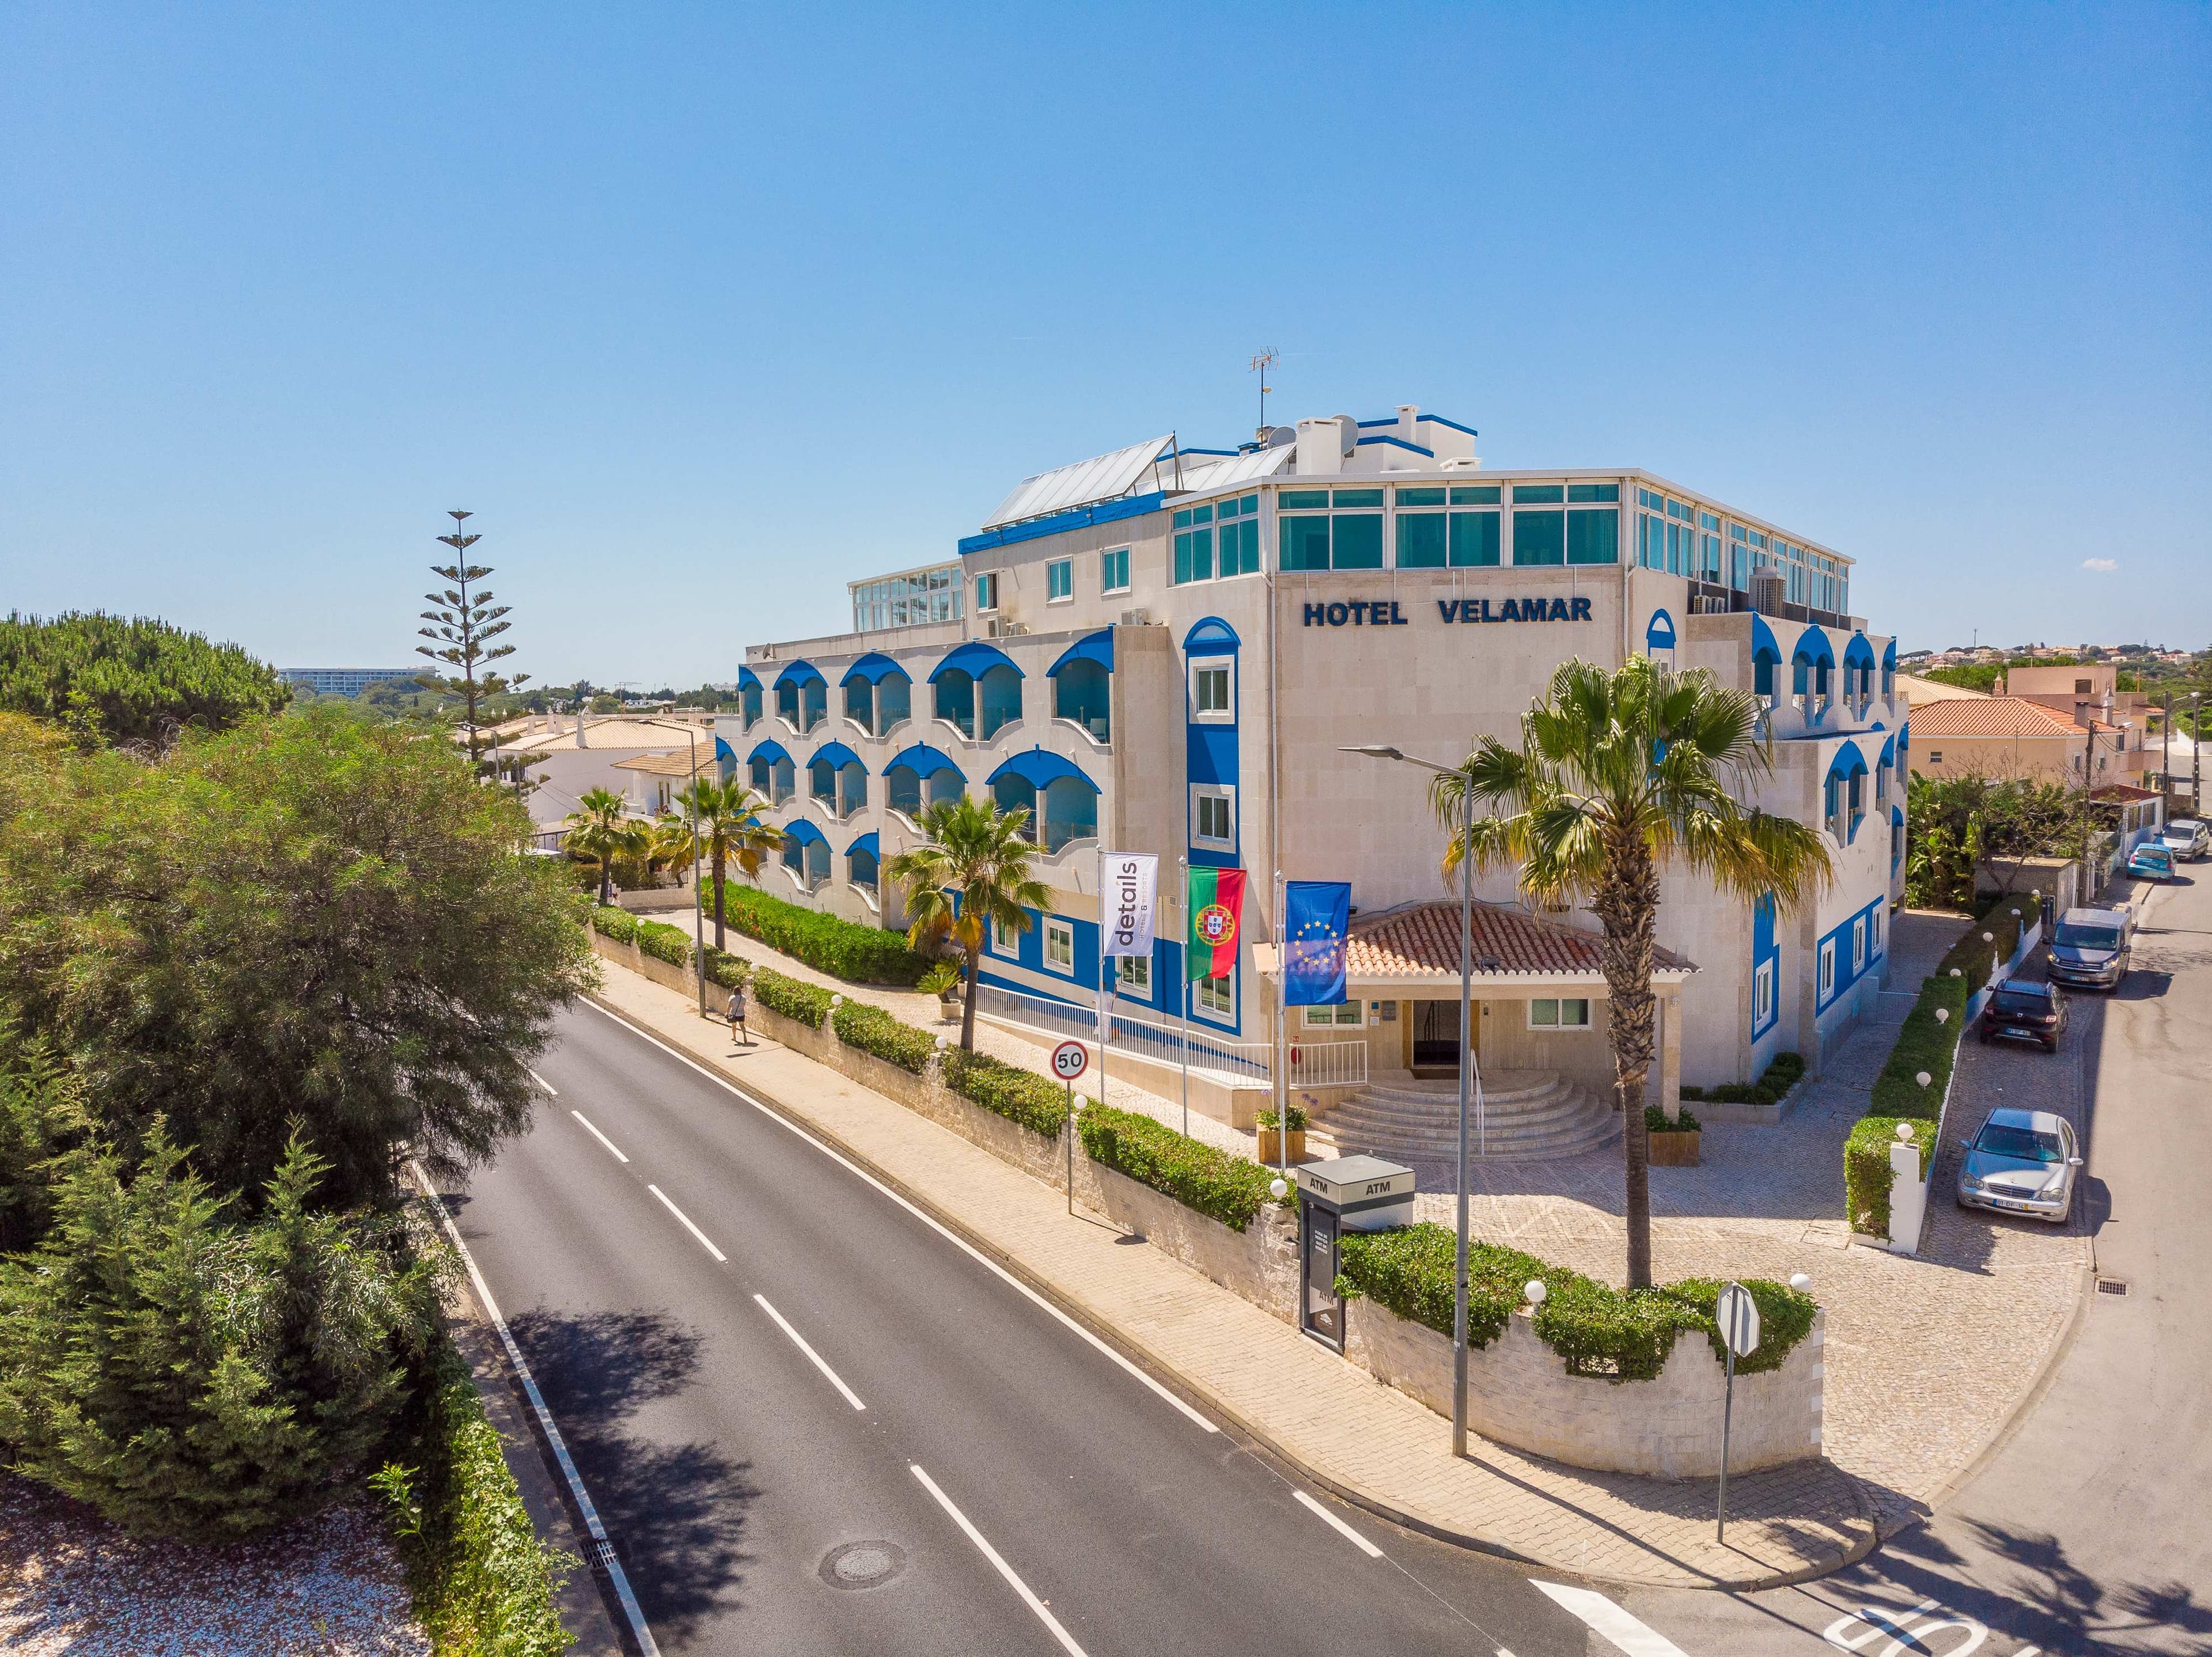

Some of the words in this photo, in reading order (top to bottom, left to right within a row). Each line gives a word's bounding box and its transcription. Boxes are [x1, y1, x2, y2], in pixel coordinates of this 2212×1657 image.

[1304, 602, 1408, 627] HOTEL
[1438, 598, 1592, 624] VELAMAR
[1115, 862, 1137, 946] details
[1058, 1052, 1082, 1069] 50
[1310, 1177, 1328, 1194] ATM
[1366, 1181, 1391, 1196] ATM
[1319, 1291, 1334, 1306] ATM
